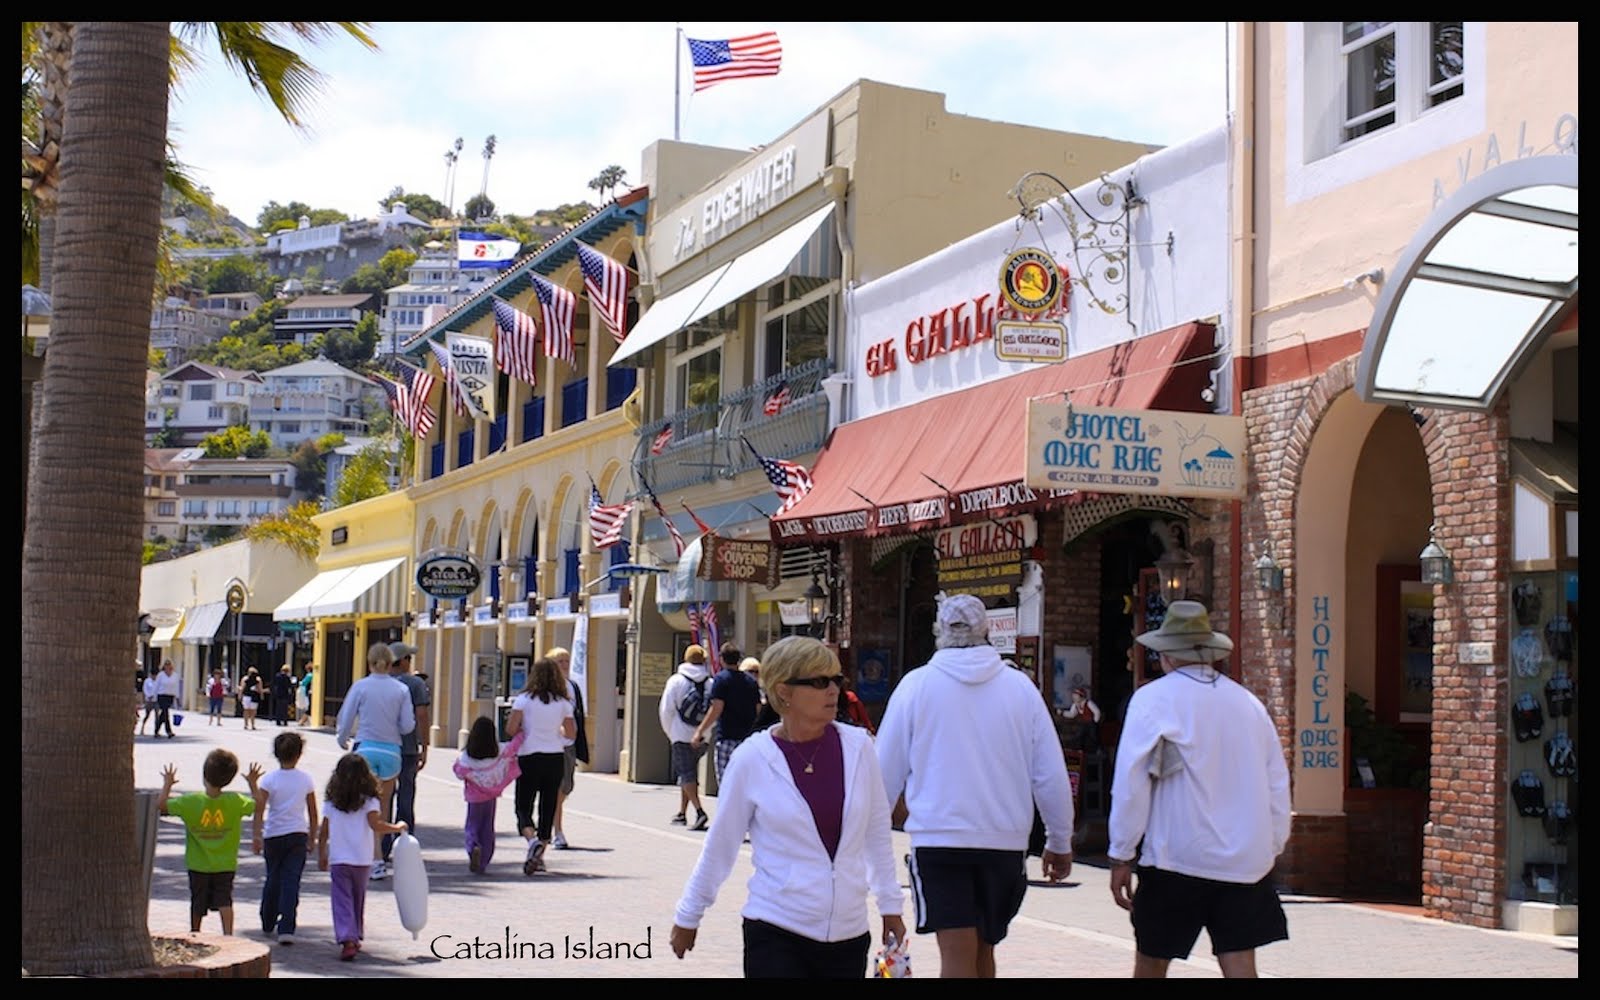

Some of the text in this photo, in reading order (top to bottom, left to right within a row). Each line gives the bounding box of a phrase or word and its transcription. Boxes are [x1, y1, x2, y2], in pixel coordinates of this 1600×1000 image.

[702, 145, 797, 235] EDGEWATER
[1006, 252, 1055, 275] PAULANER
[452, 344, 487, 354] HOTEL
[453, 360, 488, 375] VISTA
[1065, 412, 1146, 443] HOTEL
[1043, 440, 1162, 473] MAC RAE
[1056, 473, 1150, 486] OPEN AIR PATIO
[960, 481, 1038, 514] DOPPELBOCK
[725, 541, 768, 553] CATALINA
[939, 519, 1025, 558] EL GALLEON
[717, 545, 769, 568] SOUVENIR
[723, 563, 755, 579] SHOP
[1312, 596, 1331, 724] HOTEL
[1301, 729, 1338, 747] MAC
[1302, 750, 1340, 768] RAE
